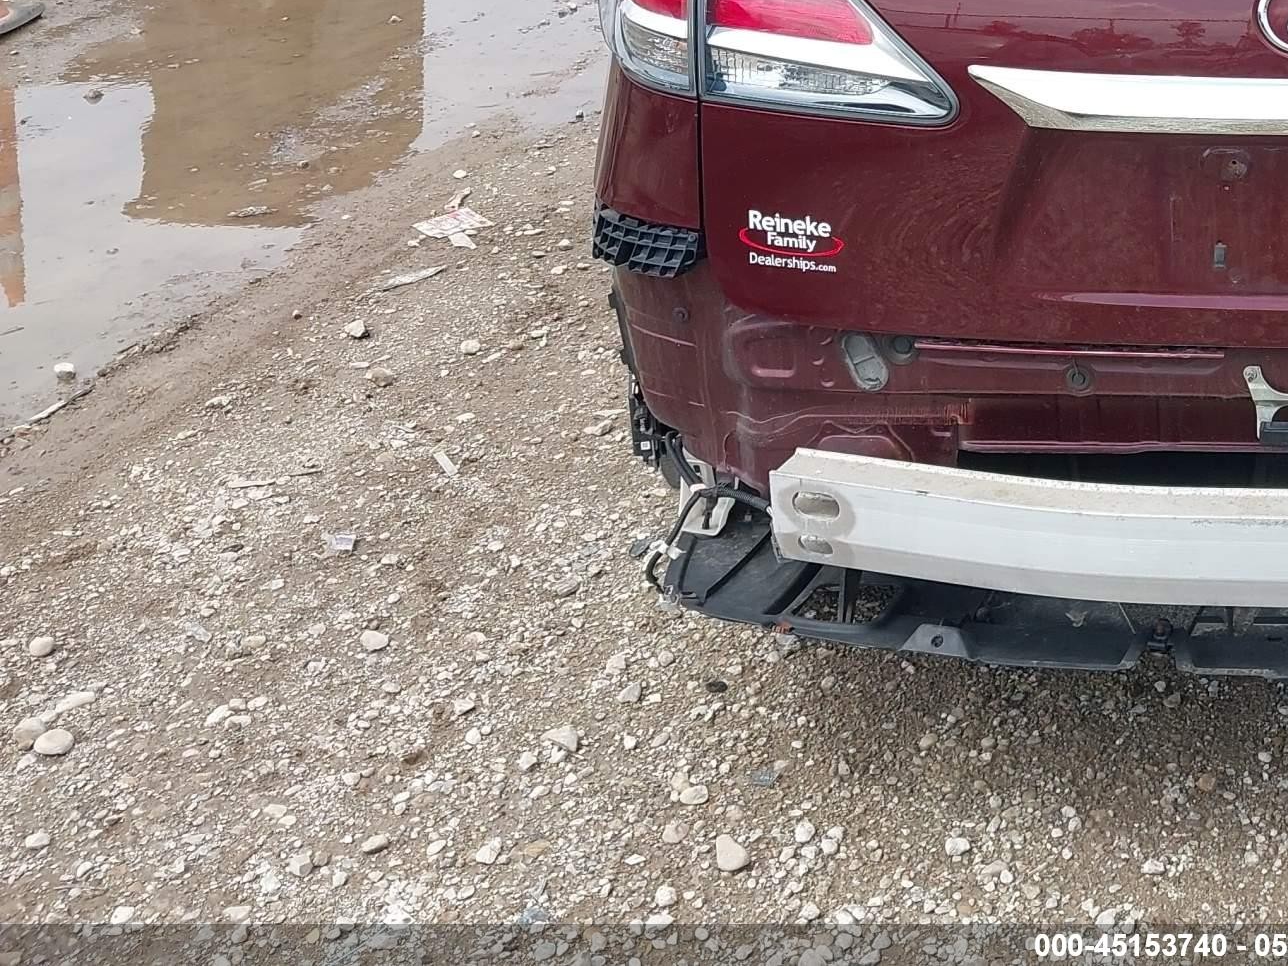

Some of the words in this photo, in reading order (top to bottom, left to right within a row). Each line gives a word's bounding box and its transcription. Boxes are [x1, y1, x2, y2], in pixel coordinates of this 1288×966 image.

[748, 209, 832, 238] Reineke
[767, 232, 817, 253] Family
[749, 252, 837, 273] Dealerships.com
